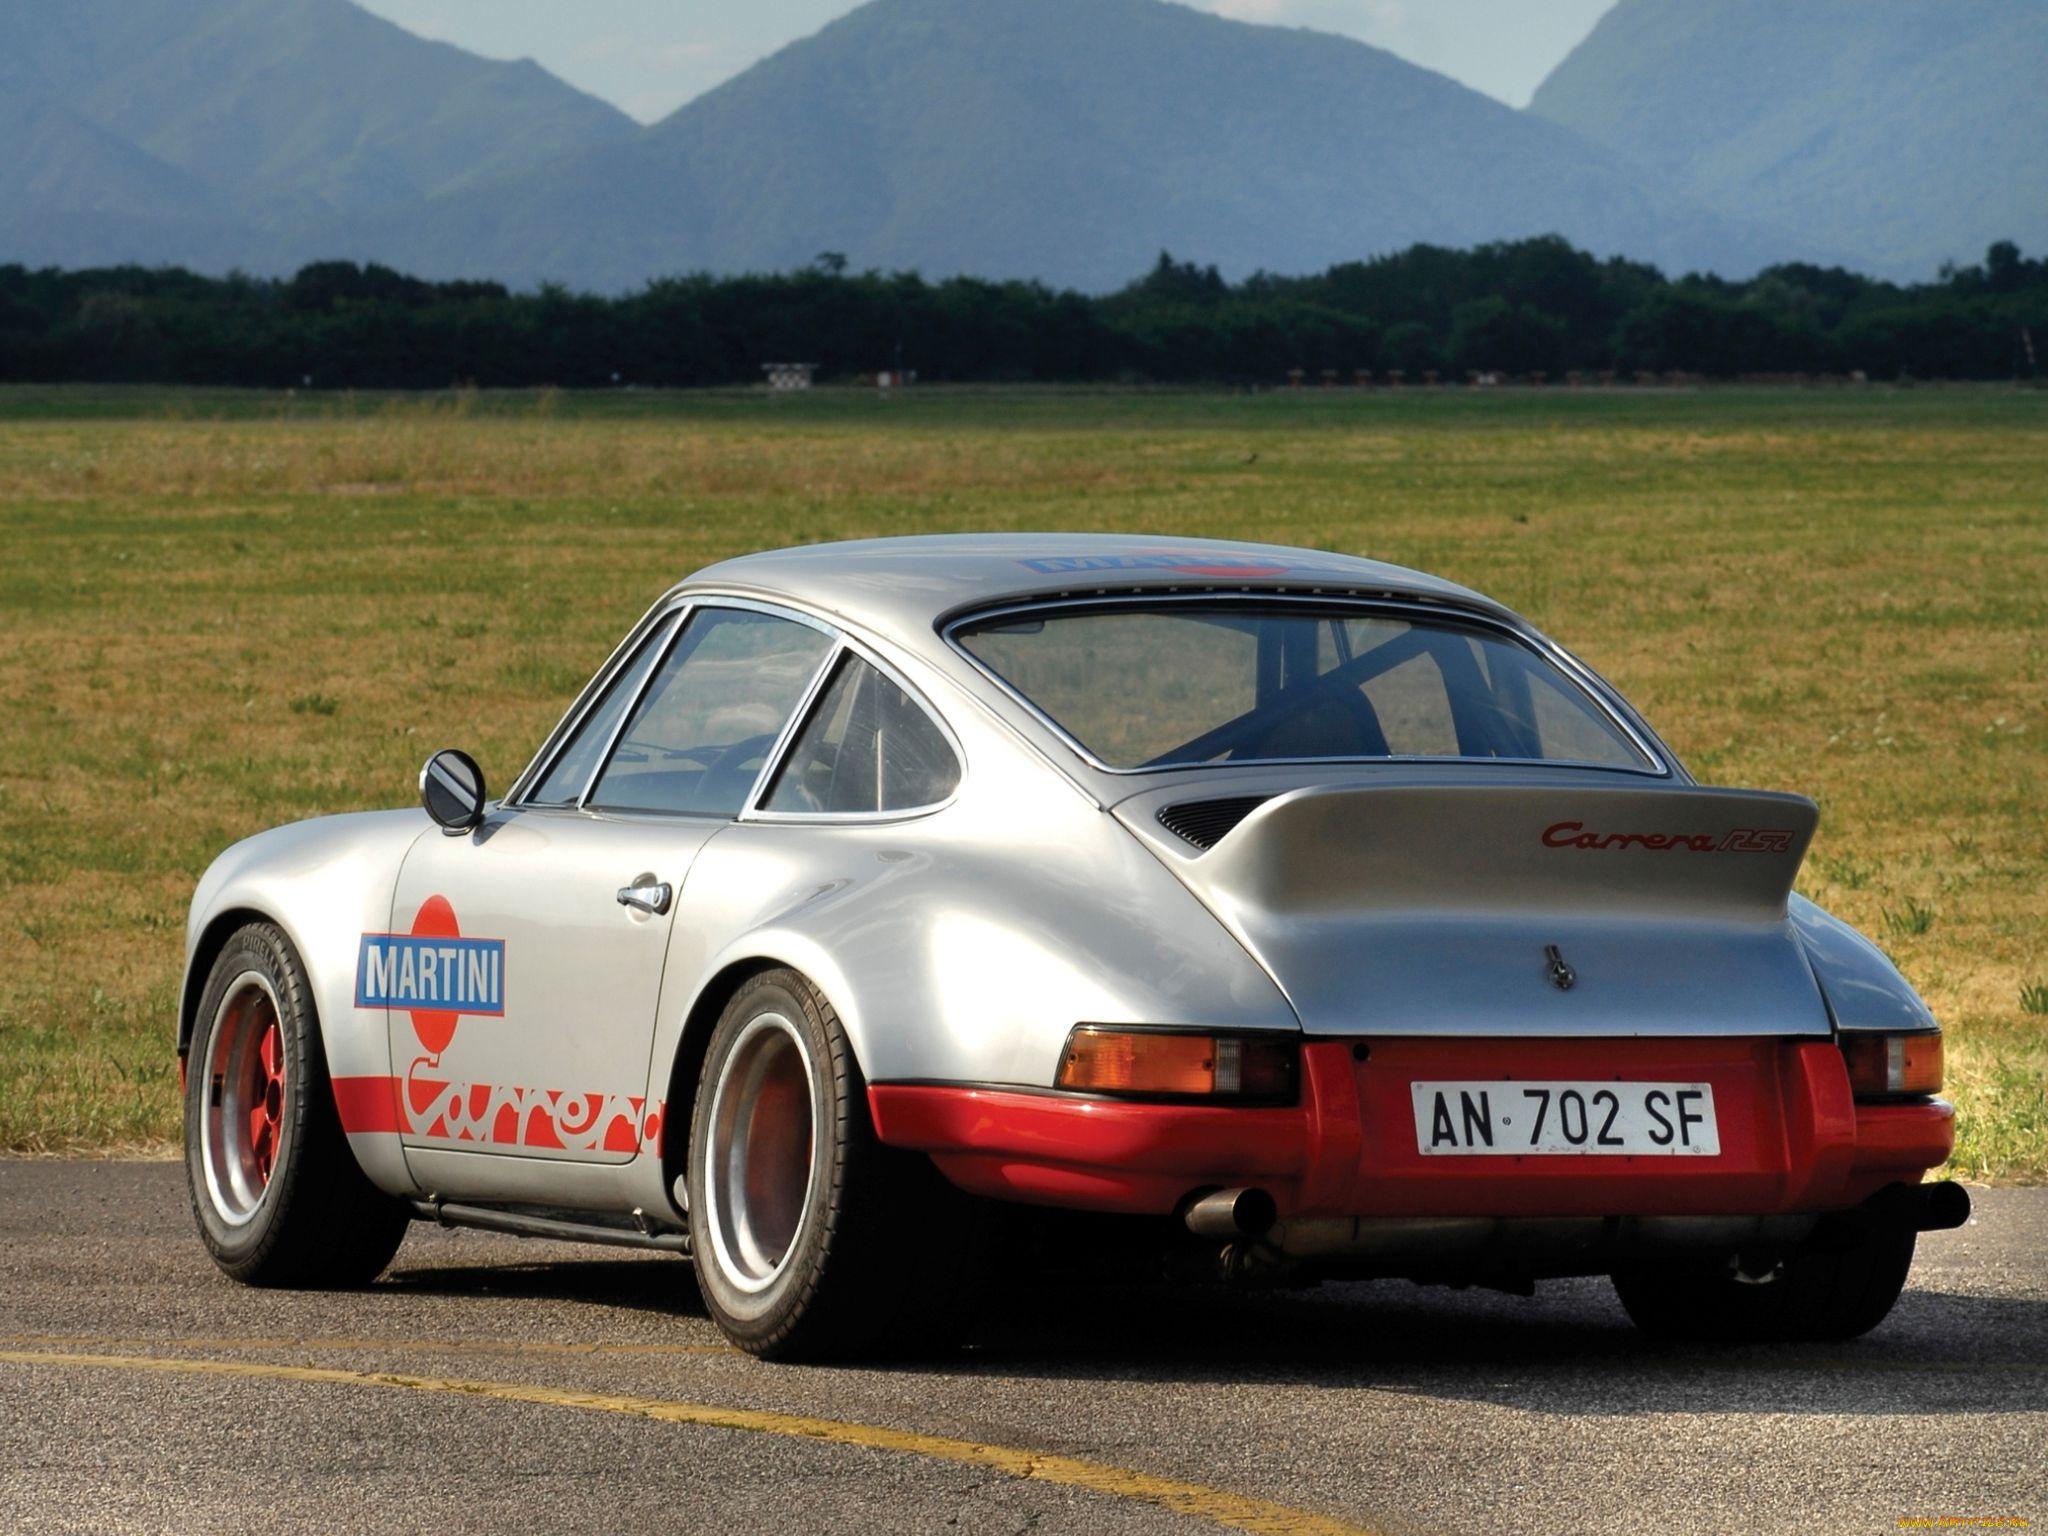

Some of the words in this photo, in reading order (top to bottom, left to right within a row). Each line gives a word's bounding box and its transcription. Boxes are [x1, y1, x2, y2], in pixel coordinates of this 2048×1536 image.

[1541, 821, 1717, 851] Carrera
[241, 934, 279, 978] PIRELLI
[365, 944, 499, 1004] MARTINI
[1431, 1090, 1494, 1147] AN
[1523, 1088, 1625, 1146] 702
[1644, 1089, 1704, 1146] SF
